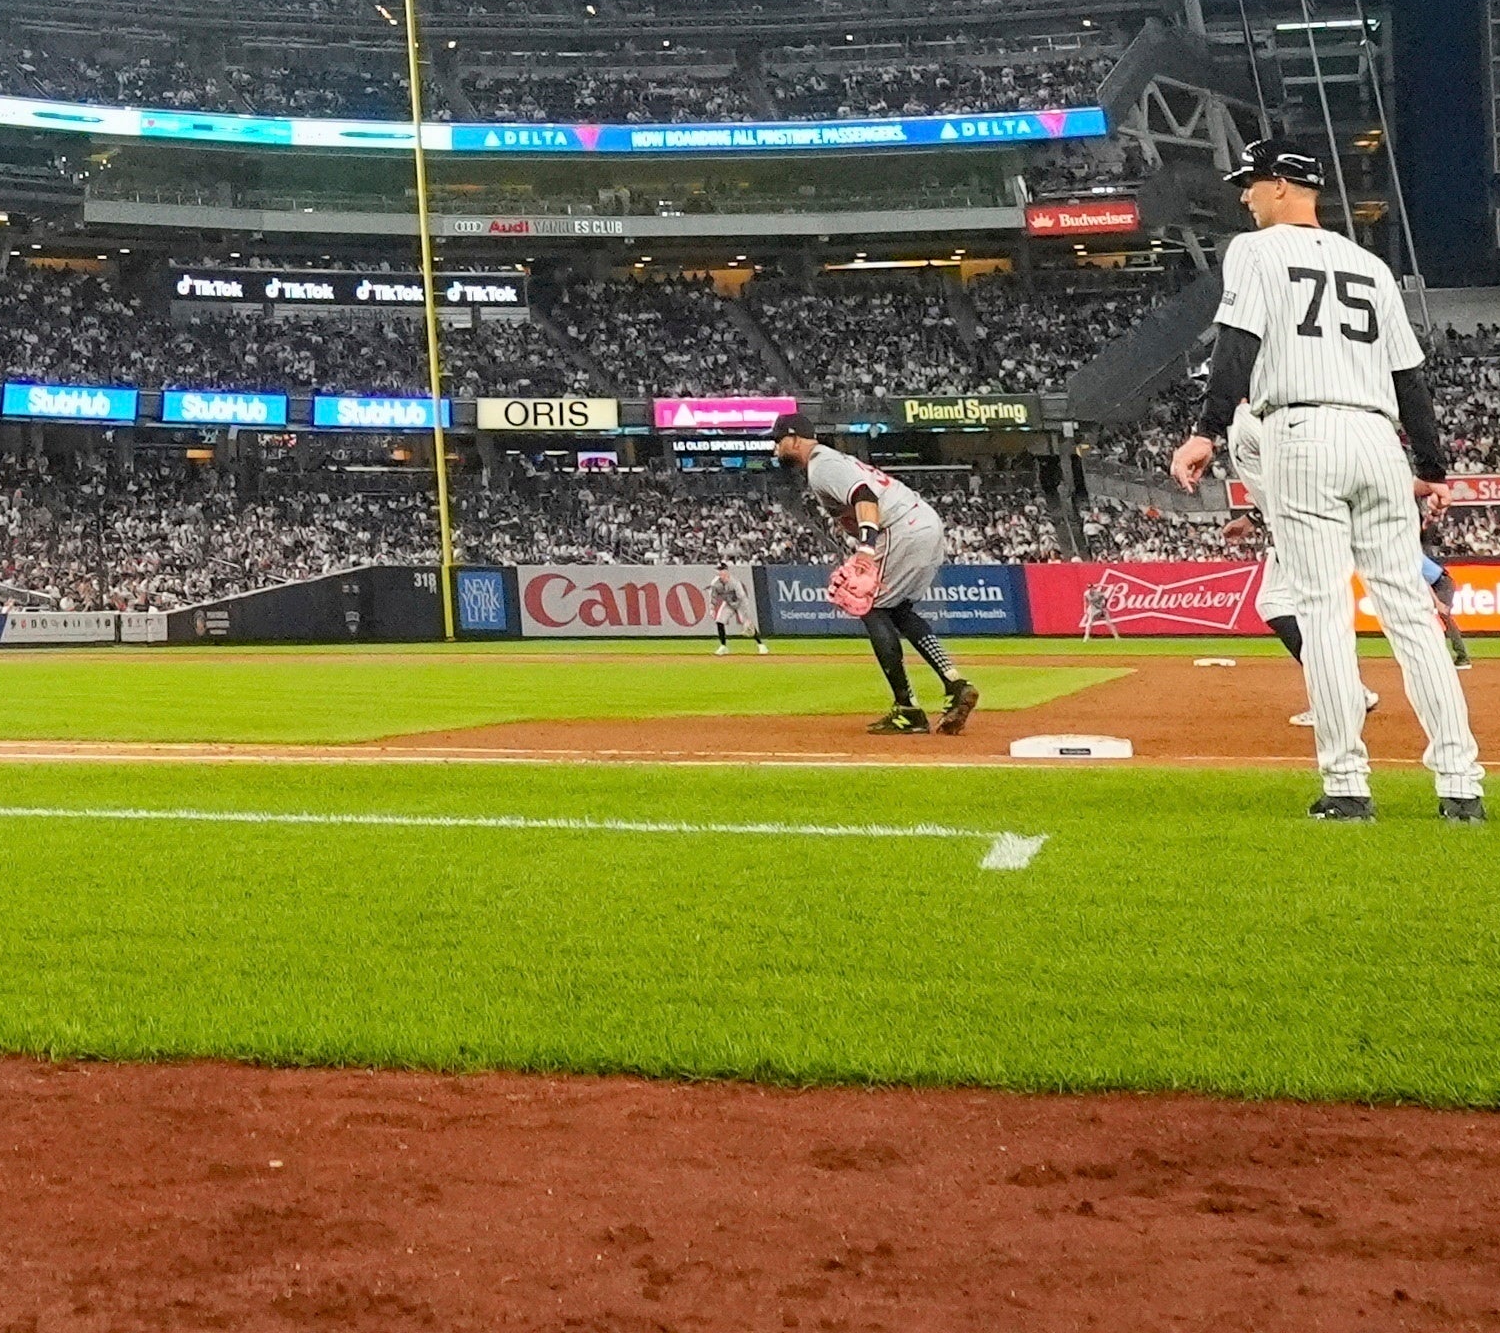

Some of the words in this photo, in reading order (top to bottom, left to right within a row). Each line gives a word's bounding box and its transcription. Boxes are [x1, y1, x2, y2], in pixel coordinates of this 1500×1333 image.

[961, 119, 1030, 136] DELTA
[503, 130, 567, 146] DELTA
[631, 130, 664, 147] NOW
[665, 129, 730, 147] BOARDING
[488, 220, 529, 234] Audi
[592, 220, 623, 234] CLUB
[1058, 211, 1135, 230] Budweiser
[193, 279, 244, 298] TikTok
[463, 284, 517, 302] TikTok
[1287, 266, 1379, 344] 75
[336, 397, 427, 426] StubHub
[503, 400, 589, 427] ORIS
[904, 399, 965, 424] Poland
[965, 398, 1027, 424] Spring
[711, 441, 745, 451] SPORTS
[413, 573, 437, 587] 318
[463, 578, 495, 594] NEW
[461, 593, 500, 609] YORK
[1101, 582, 1242, 612] Budweiser
[466, 607, 499, 623] LIFE
[780, 608, 817, 620] Science
[817, 609, 834, 620] and
[938, 609, 973, 620] Human
[974, 608, 1006, 620] Health
